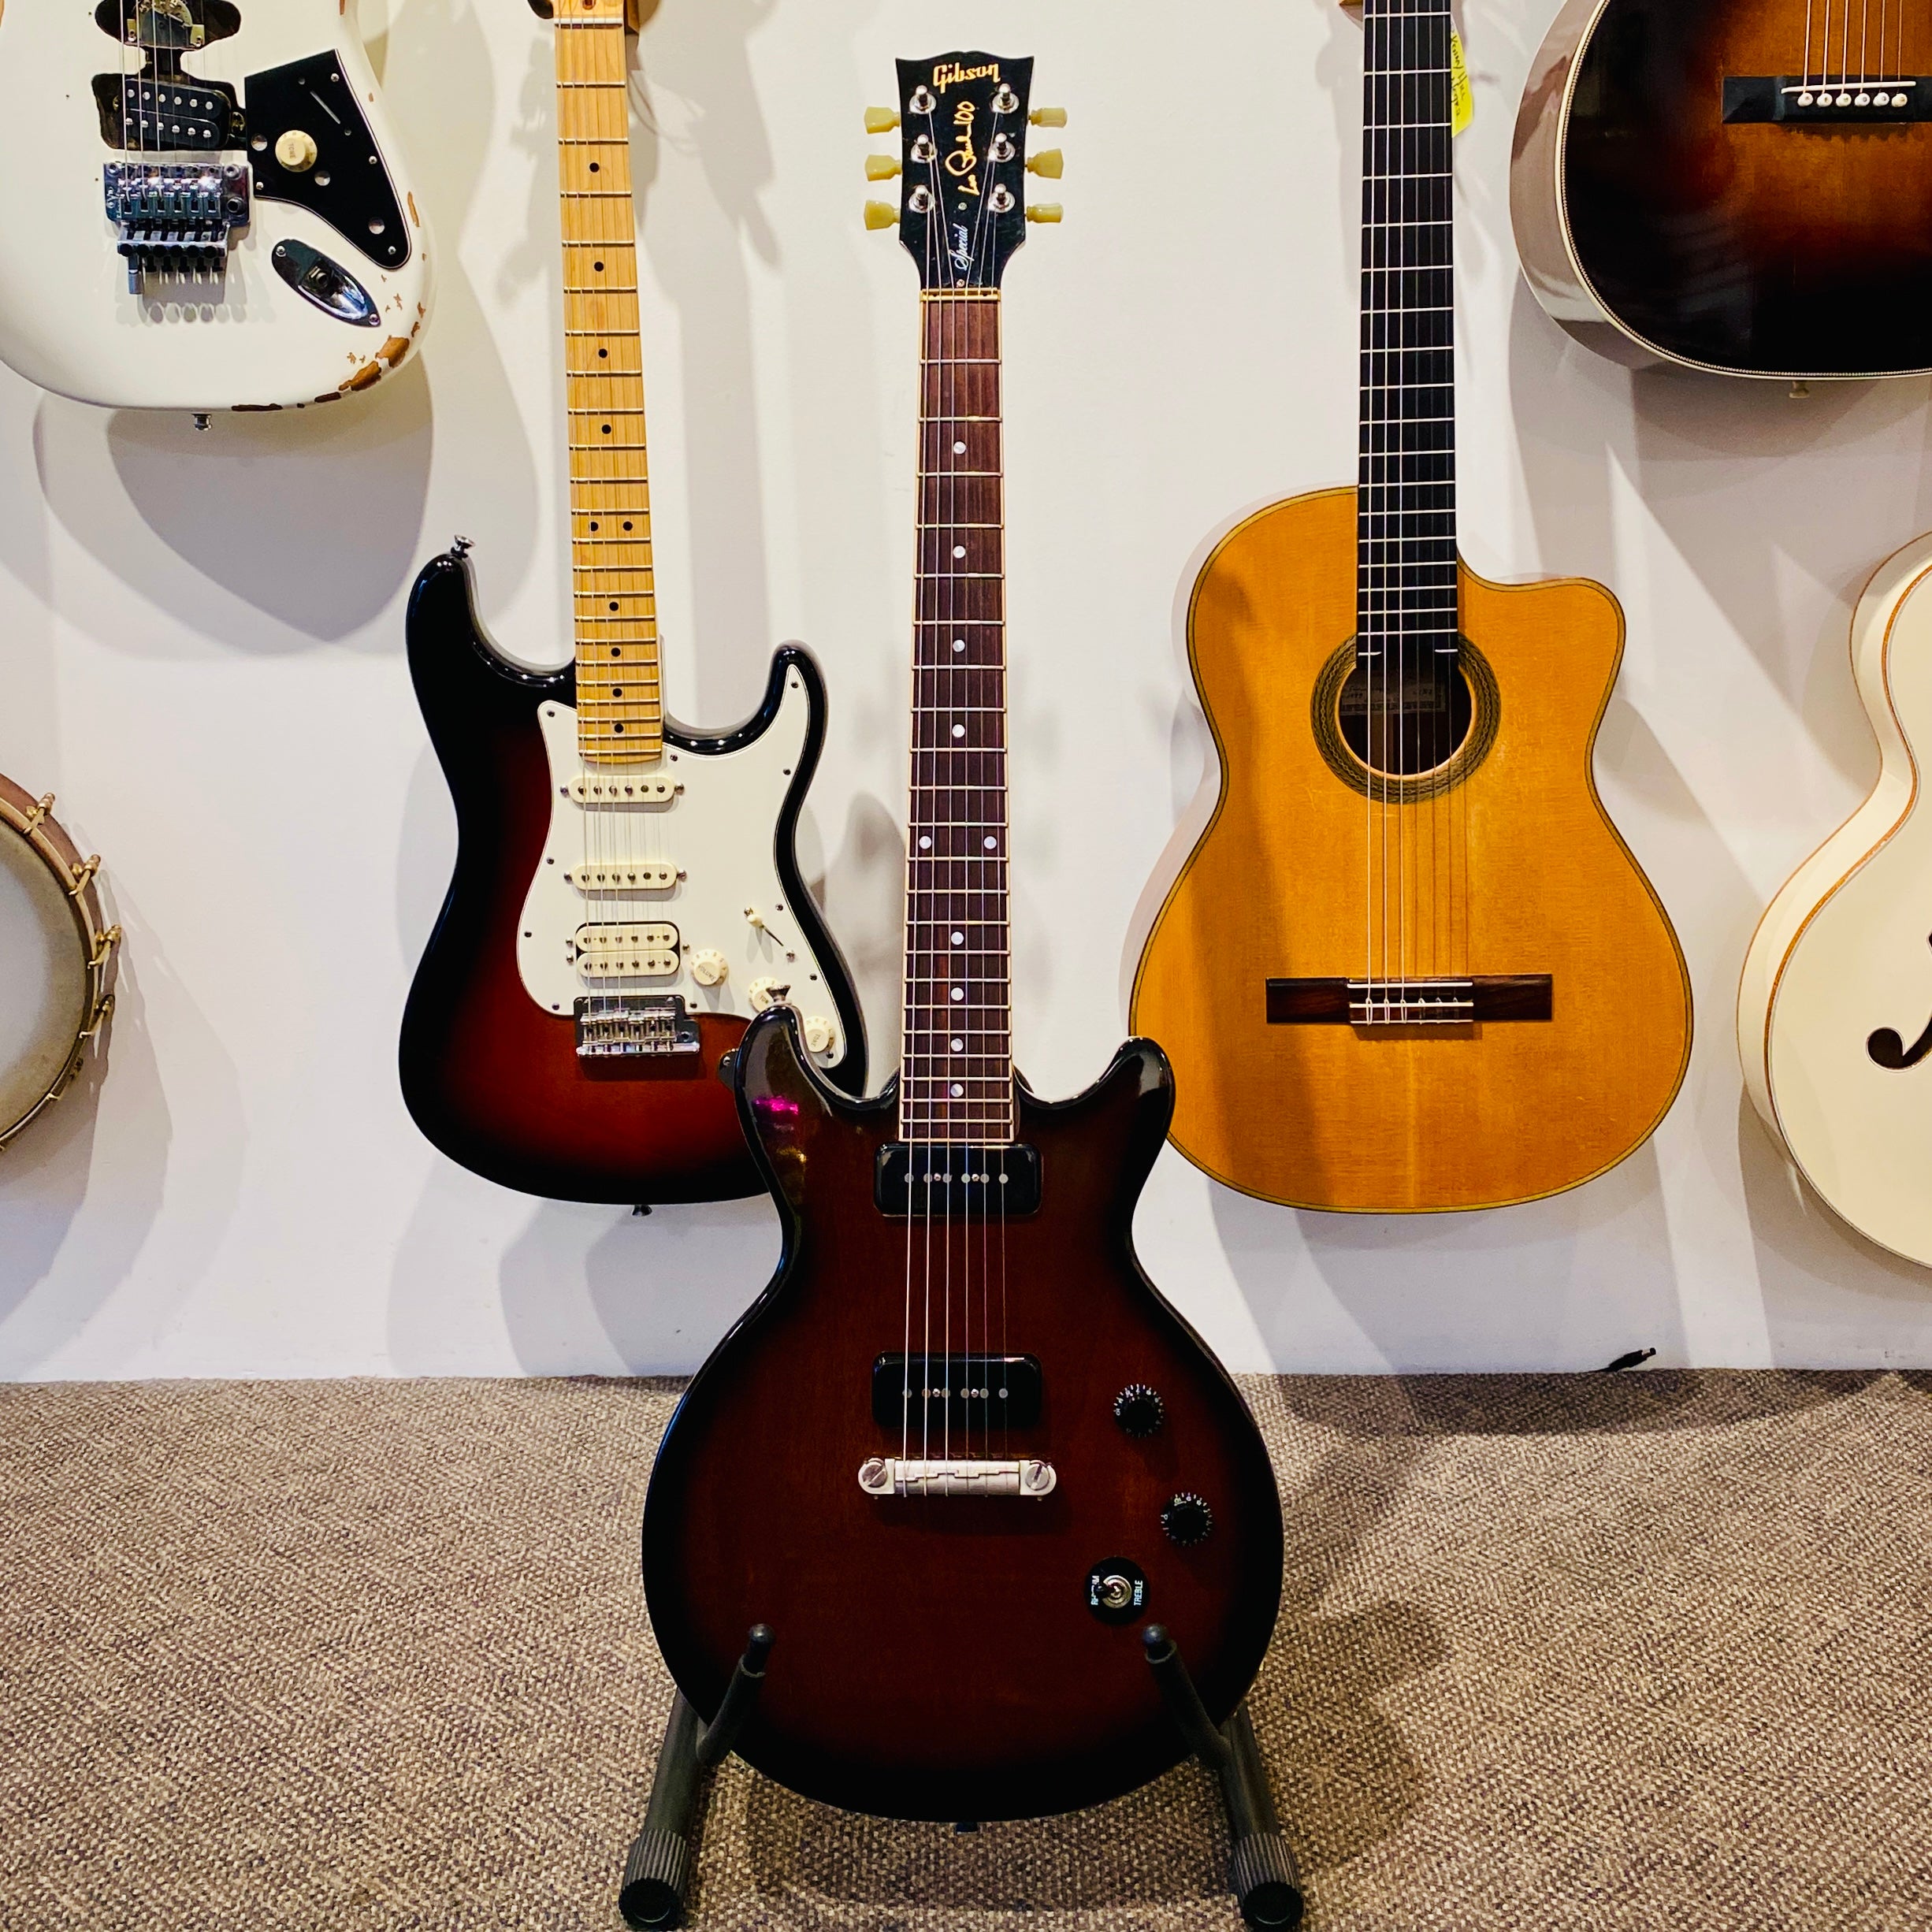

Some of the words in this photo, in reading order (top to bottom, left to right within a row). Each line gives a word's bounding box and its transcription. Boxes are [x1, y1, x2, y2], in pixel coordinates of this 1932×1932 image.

[933, 61, 1001, 94] Gibson
[948, 222, 975, 271] Special
[1134, 1580, 1143, 1606] TREBLE
